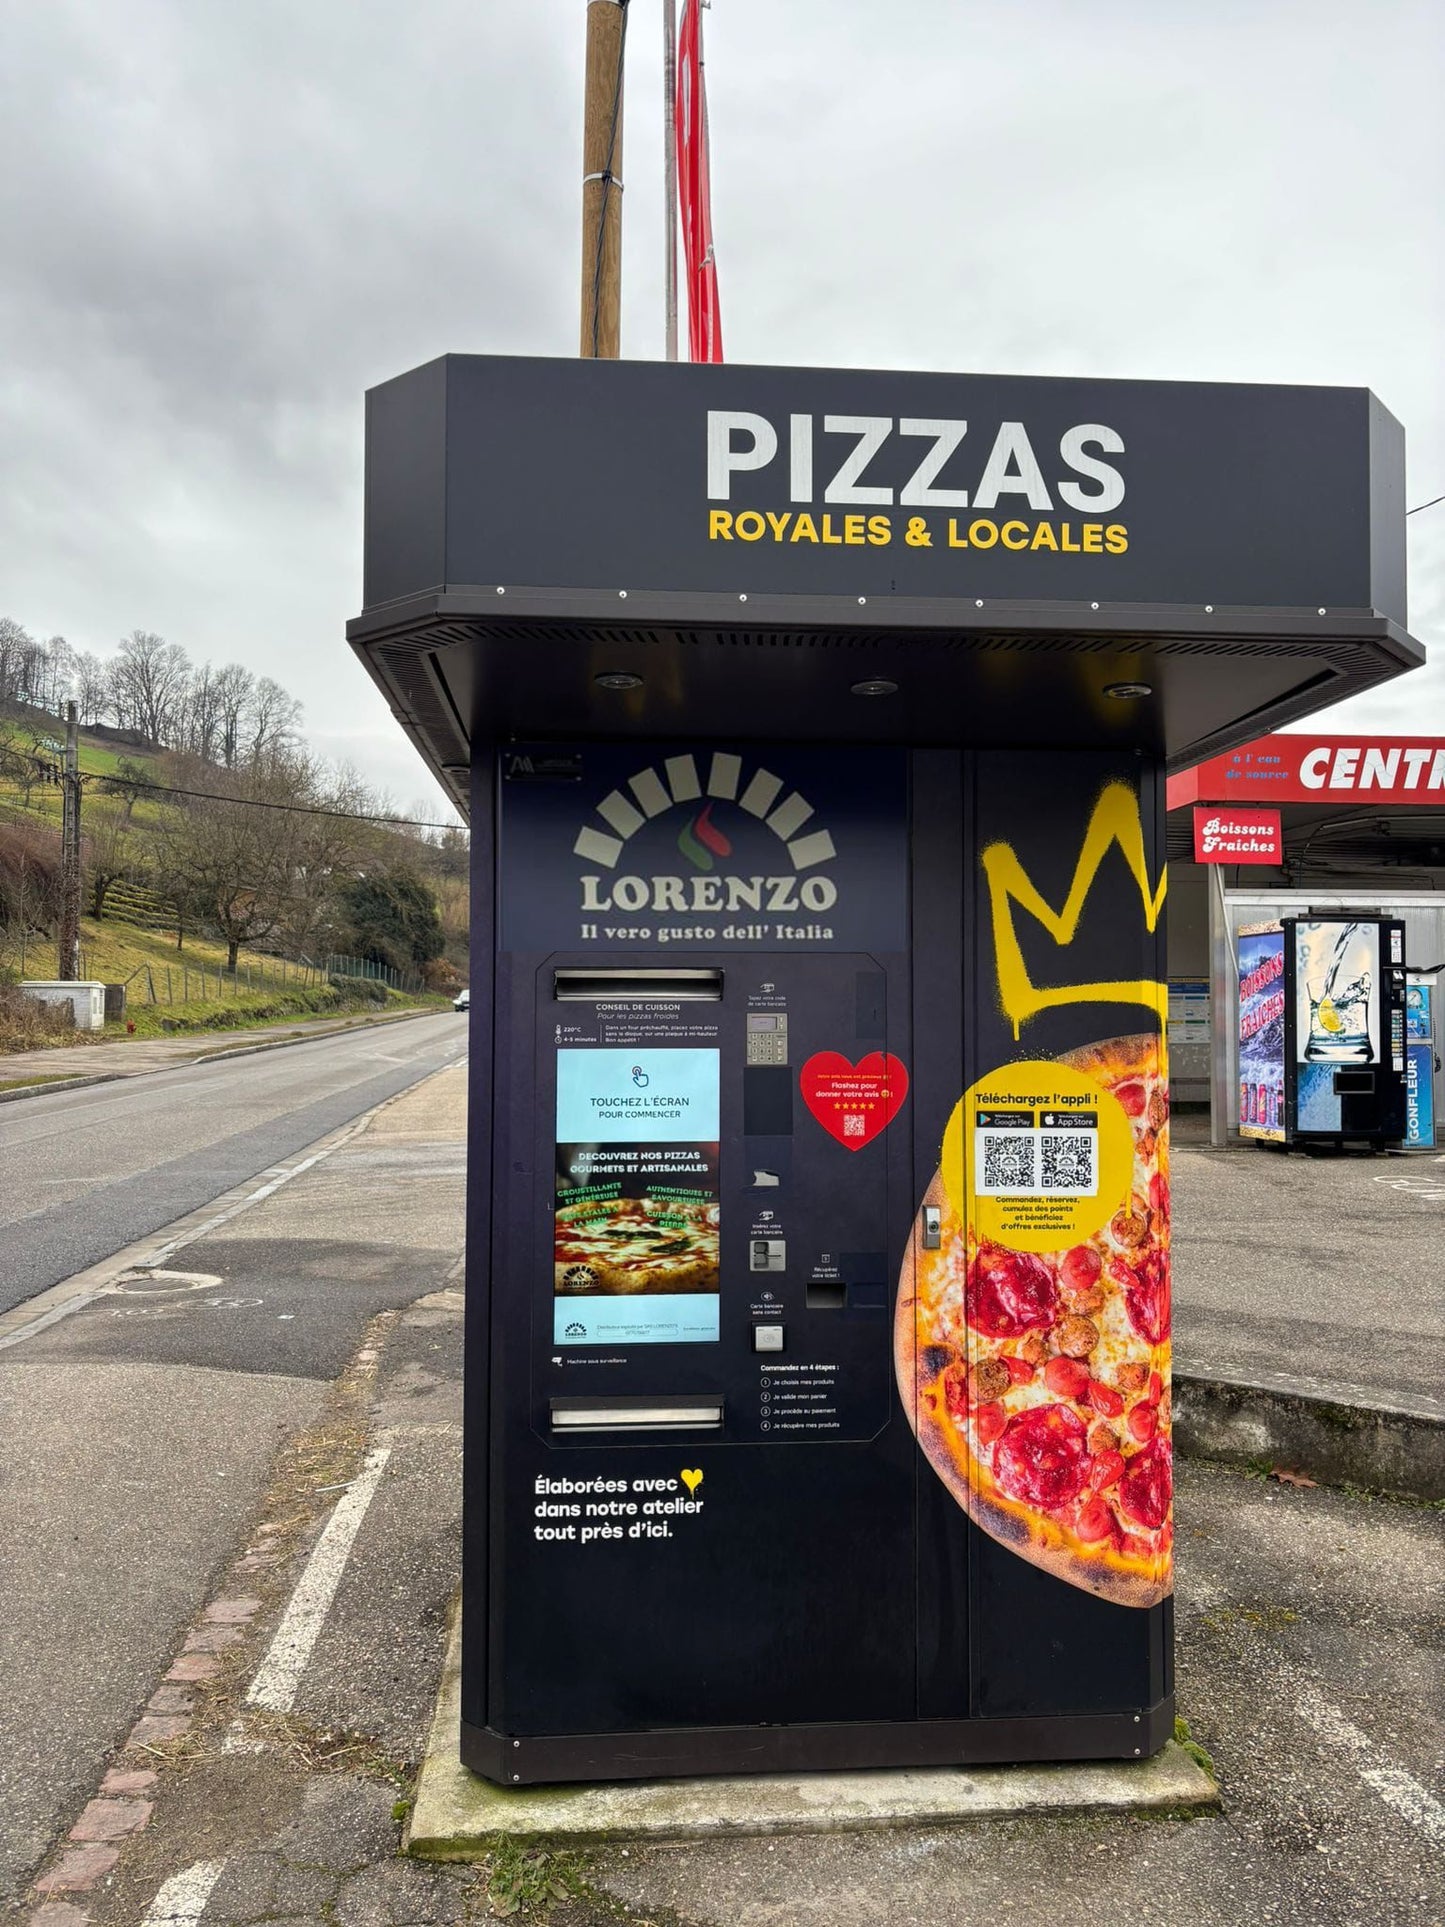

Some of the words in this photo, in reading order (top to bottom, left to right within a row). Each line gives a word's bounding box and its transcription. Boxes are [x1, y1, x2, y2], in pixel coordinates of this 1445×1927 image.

[707, 410, 1126, 513] PIZZAS
[709, 510, 893, 545] ROYALES
[905, 517, 933, 547] &
[948, 518, 1129, 554] LOCALES
[1245, 771, 1289, 779] source
[1202, 817, 1274, 836] Boissons
[1202, 836, 1275, 853] Fraiches
[579, 875, 838, 911] LORENZO
[581, 924, 598, 939] Il
[604, 927, 651, 939] vero
[658, 925, 716, 942] gusto
[776, 924, 834, 939] Italia
[1239, 950, 1284, 1003] BOISSONS
[595, 1003, 631, 1011] CONSEIL
[632, 1003, 643, 1011] DE
[645, 1003, 681, 1011] CUISSON
[597, 1012, 615, 1020] Pour
[616, 1012, 627, 1020] les
[628, 1012, 651, 1021] pizzas
[653, 1012, 680, 1020] froides
[1239, 988, 1285, 1041] FRAICHES
[590, 1097, 642, 1107] TOUCHEZ
[643, 1095, 690, 1107] L'ÉCRAN
[975, 1092, 1050, 1107] Téléchargez
[1094, 1094, 1098, 1104] !
[1408, 1059, 1419, 1140] GONFLEUR
[598, 1111, 623, 1119] POUR
[624, 1110, 681, 1119] COMMENCER
[994, 1118, 1019, 1127] Google
[1019, 1118, 1031, 1127] Play
[1057, 1118, 1074, 1127] App
[1074, 1118, 1094, 1126] Store
[578, 1152, 639, 1161] DECOUVREZ
[640, 1152, 662, 1160] NOS
[664, 1151, 701, 1160] PIZZAS
[570, 1164, 625, 1173] GOURMETS
[626, 1164, 638, 1172] ET
[640, 1163, 709, 1172] ARTISANALES
[1034, 1204, 1048, 1212] des
[1049, 1204, 1073, 1214] points
[1025, 1213, 1063, 1221] bénéficiez
[1033, 1222, 1072, 1230] exclusives
[815, 1364, 836, 1372] étapes
[534, 1474, 628, 1494] Élaborées
[632, 1479, 678, 1492] avec
[534, 1501, 581, 1517] dans
[586, 1501, 638, 1516] notre
[643, 1497, 704, 1514] atelier
[534, 1524, 576, 1540] tout
[581, 1522, 623, 1544] près
